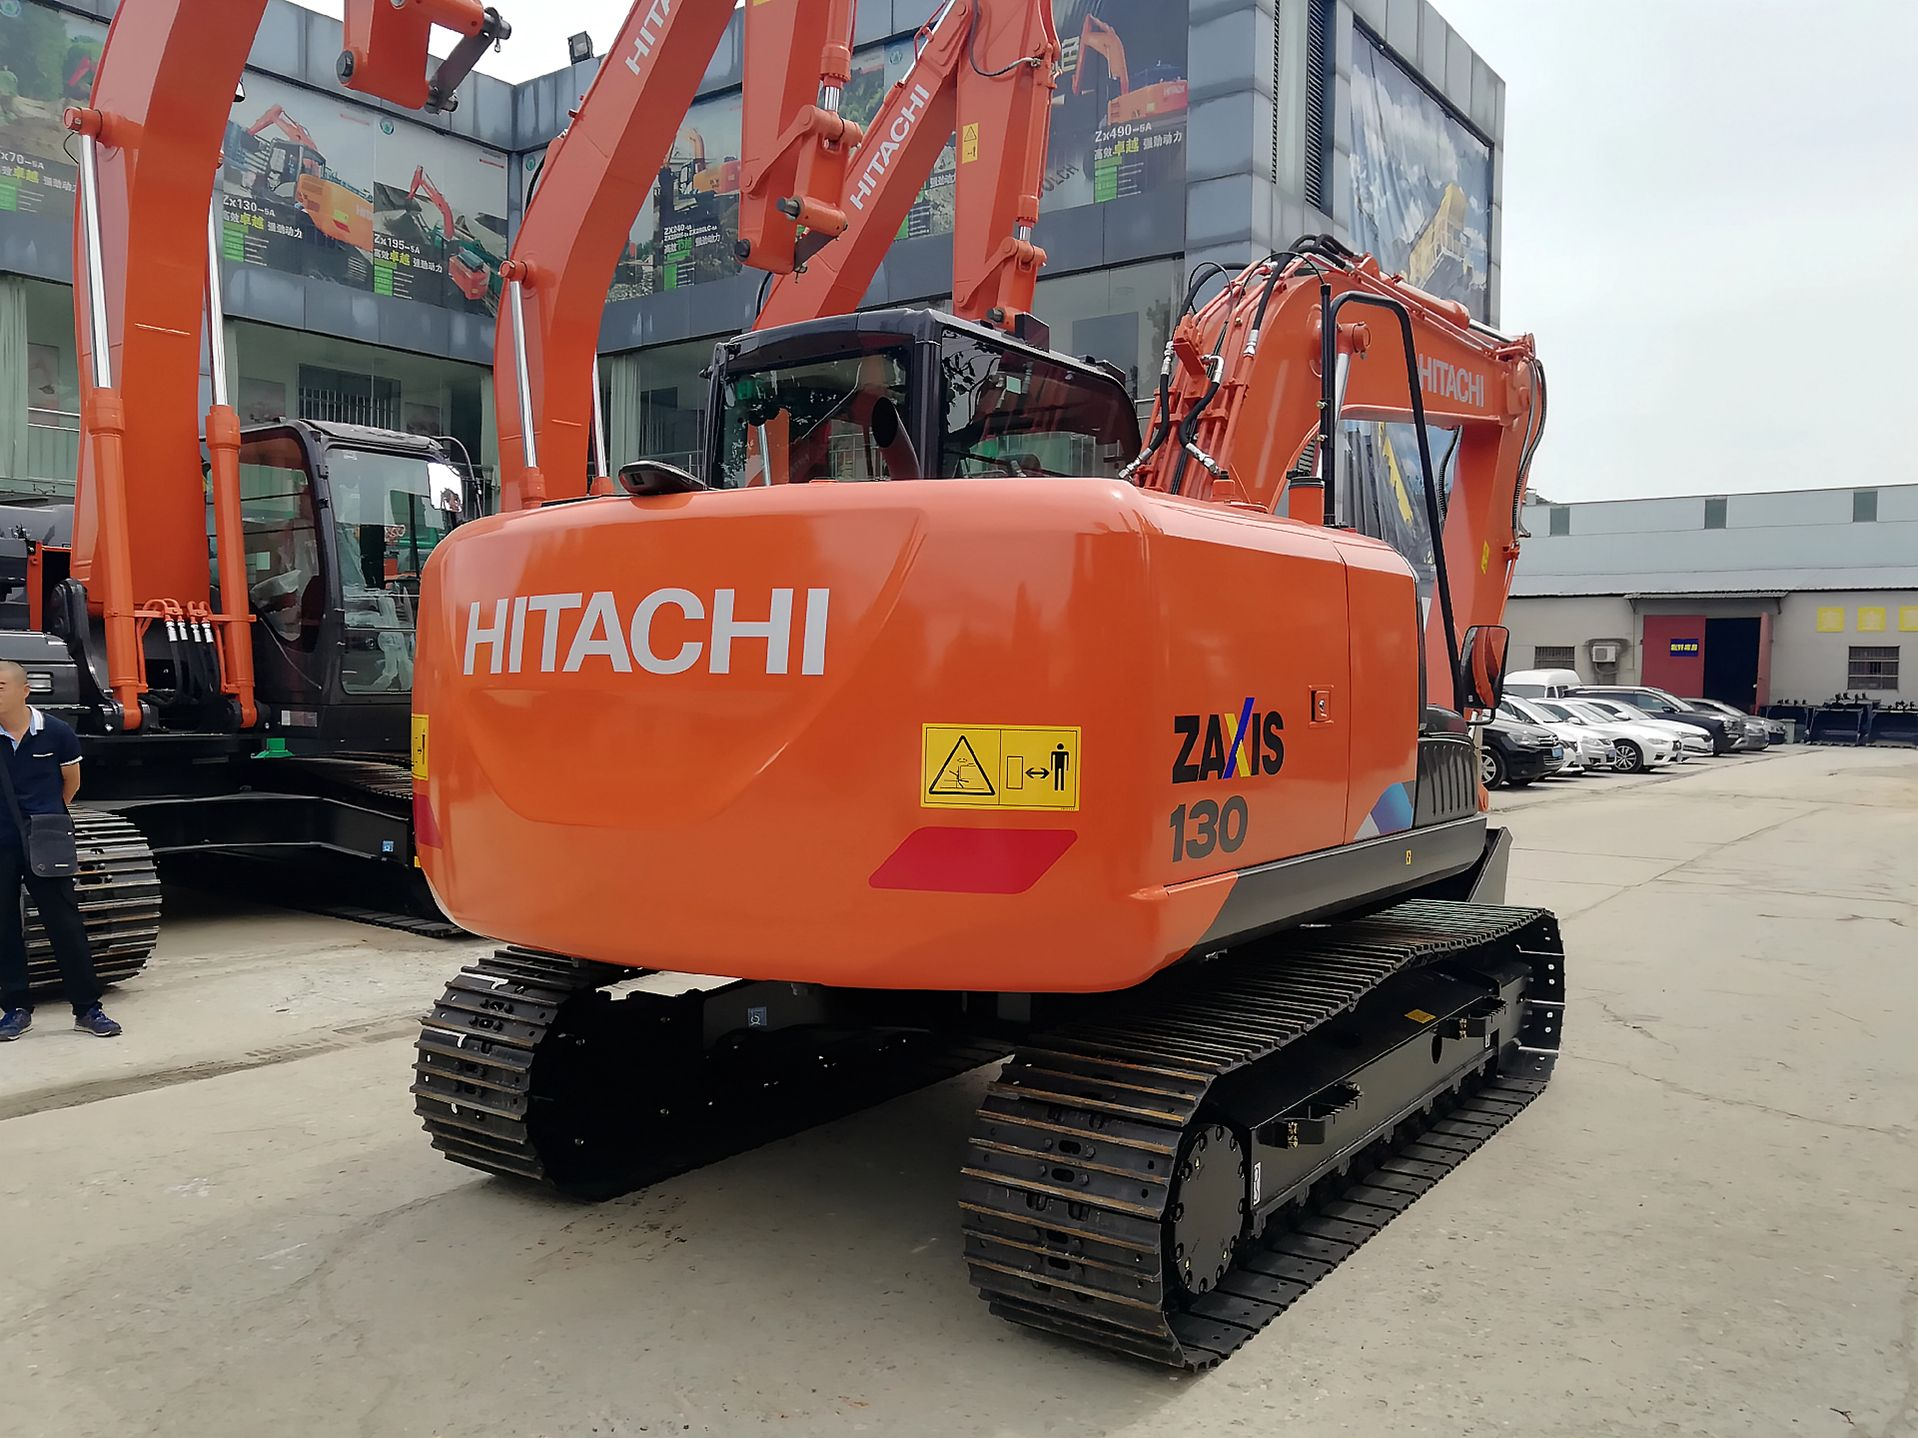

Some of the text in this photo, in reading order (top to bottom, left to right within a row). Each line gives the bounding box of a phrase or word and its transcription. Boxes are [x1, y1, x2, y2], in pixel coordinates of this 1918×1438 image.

[850, 84, 930, 210] HITACHI
[1418, 353, 1484, 407] HITACHI
[464, 588, 829, 676] HITACHI
[1172, 697, 1284, 783] ZAXIS
[1170, 795, 1248, 862] 130
